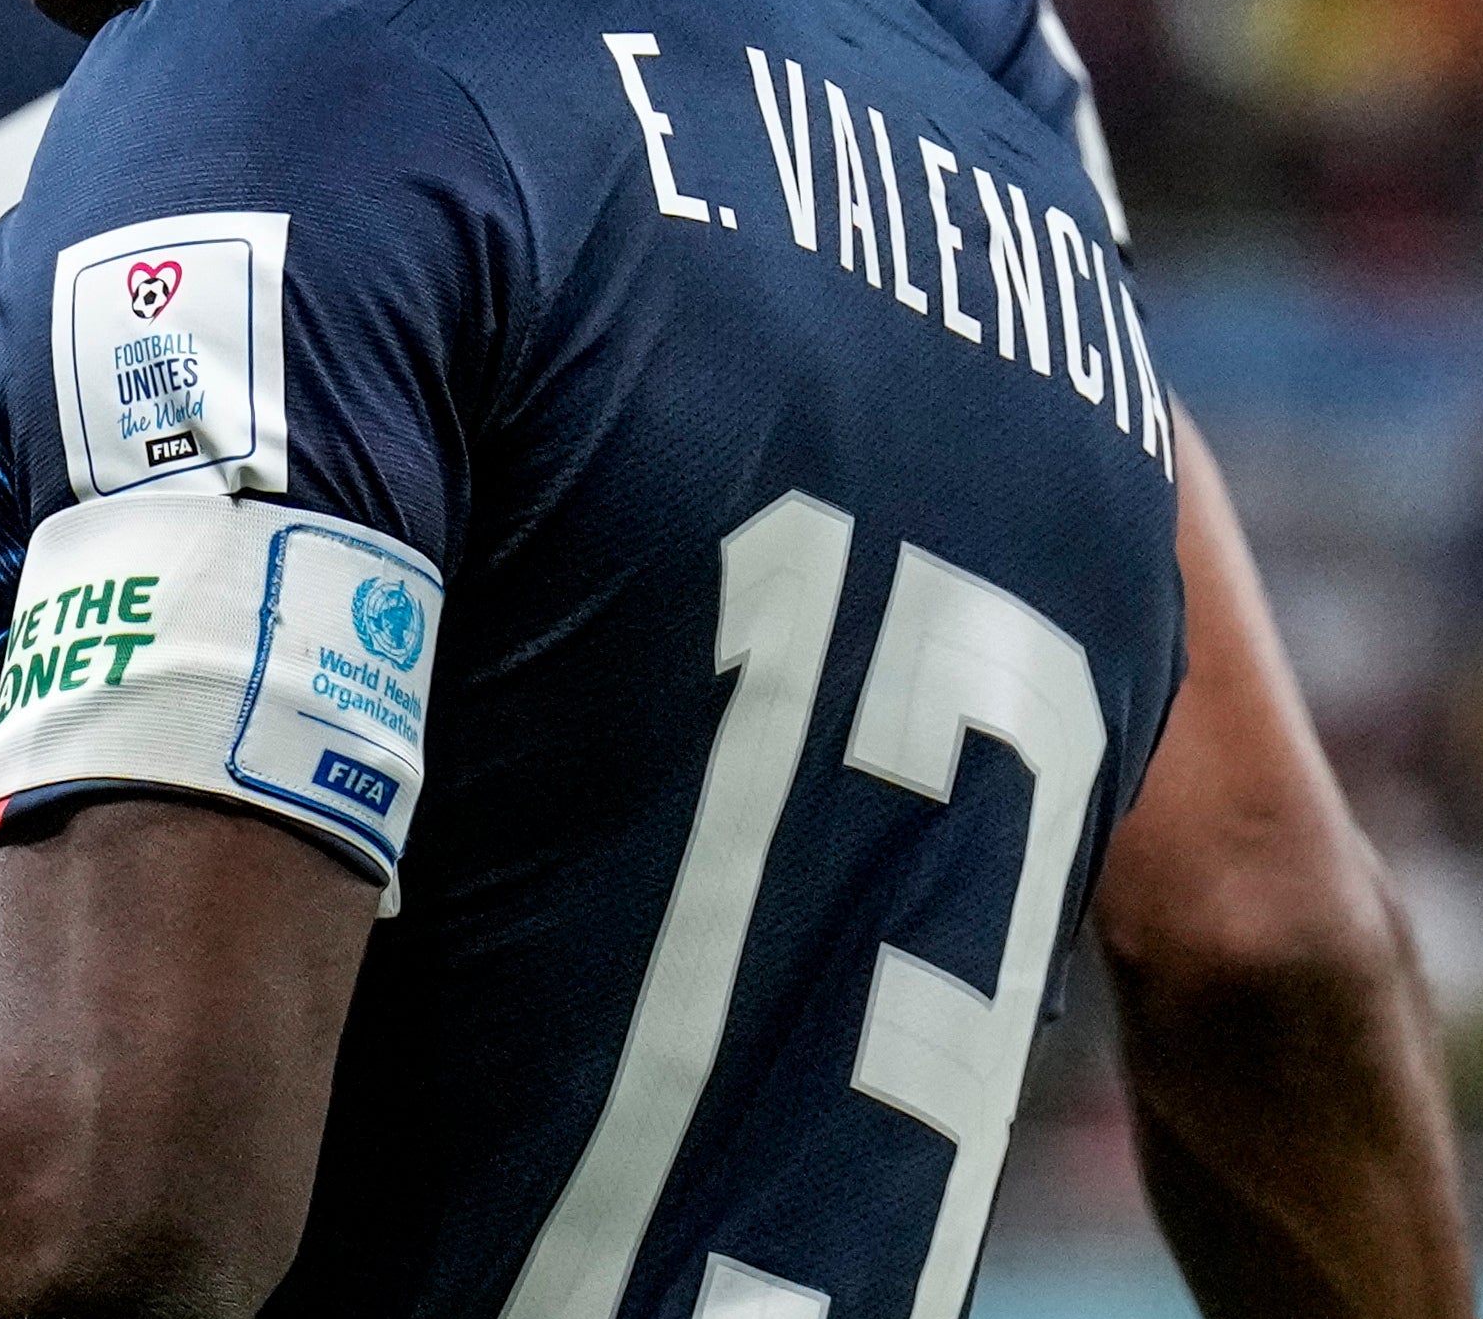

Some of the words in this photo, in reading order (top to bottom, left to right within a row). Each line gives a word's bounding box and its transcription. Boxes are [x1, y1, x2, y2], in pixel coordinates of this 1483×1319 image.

[602, 32, 738, 230] E.
[745, 45, 1174, 483] VALENCIA
[114, 332, 199, 370] FOOTBALL
[117, 357, 199, 406] UNITES
[117, 407, 152, 440] the
[154, 389, 205, 430] World
[151, 437, 193, 461] FIFA
[54, 576, 161, 635] THE
[319, 646, 381, 692] World
[384, 674, 423, 722] Health
[312, 672, 419, 748] Organization
[327, 759, 387, 806] FIFA
